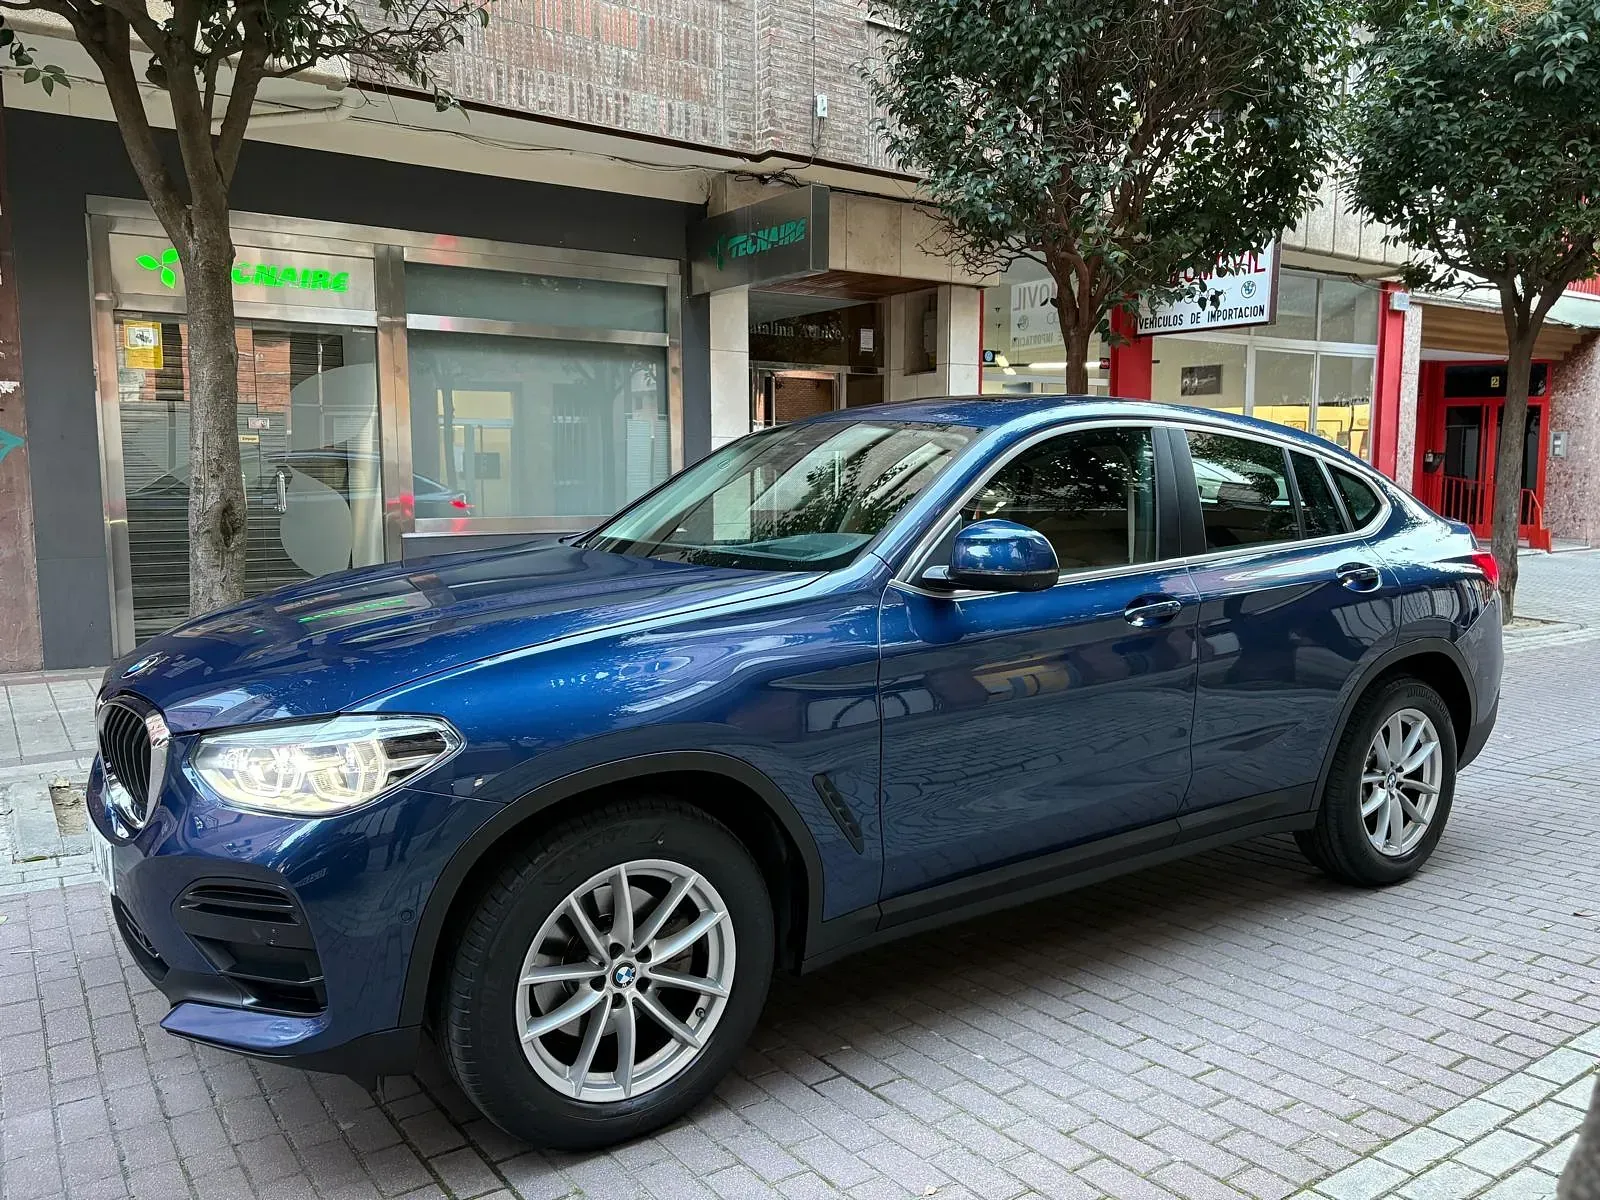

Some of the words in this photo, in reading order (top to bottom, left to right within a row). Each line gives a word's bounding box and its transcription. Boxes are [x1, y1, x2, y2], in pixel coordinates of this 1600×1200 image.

[728, 216, 807, 258] TECNAIRE
[231, 261, 349, 293] CNAIRE
[749, 320, 795, 337] atalina
[1139, 313, 1184, 330] VEHICULOS
[1190, 312, 1201, 324] DE
[1207, 304, 1265, 323] IMPORTACION
